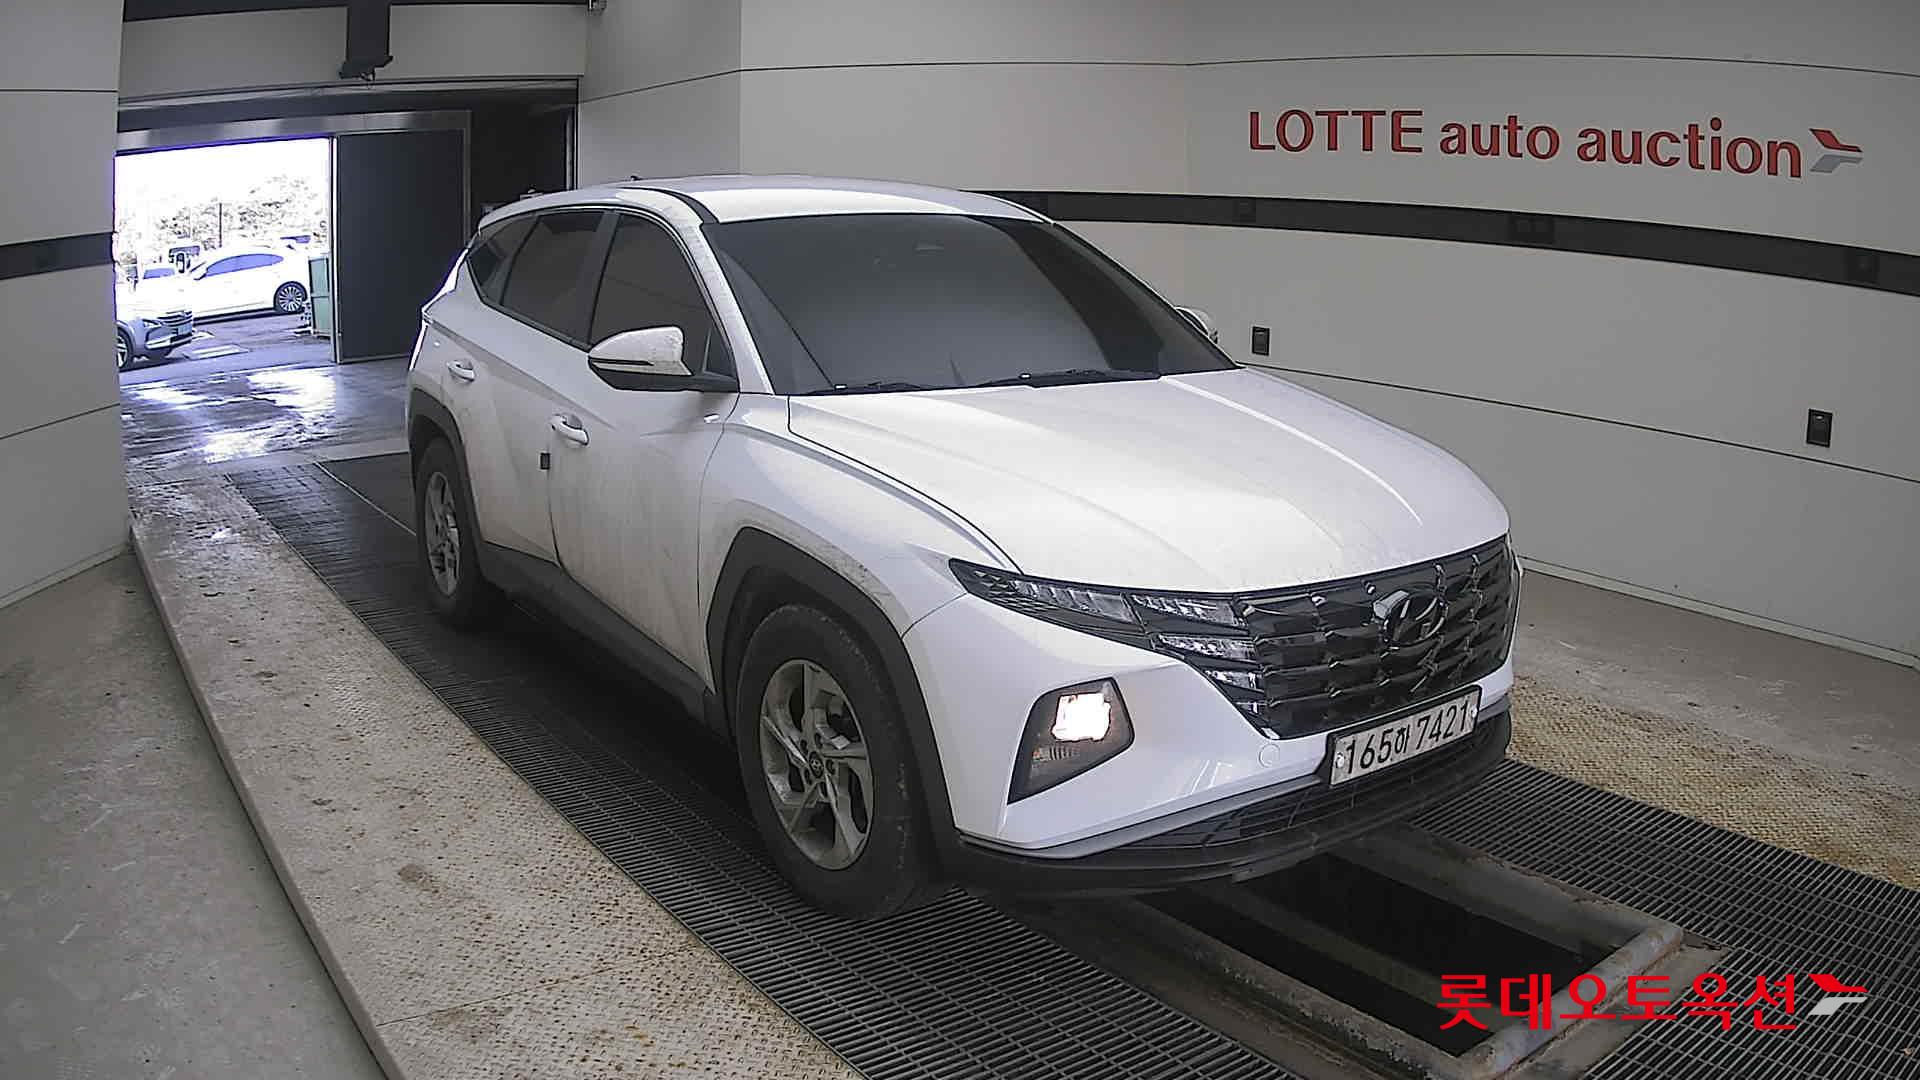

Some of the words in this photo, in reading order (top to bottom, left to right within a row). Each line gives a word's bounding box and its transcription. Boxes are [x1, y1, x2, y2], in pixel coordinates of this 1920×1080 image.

[1248, 110, 1424, 154] LOTTE
[1439, 115, 1561, 161] auto
[1576, 117, 1803, 178] auction
[1346, 724, 1410, 774] 165하
[1415, 699, 1469, 750] 7421
